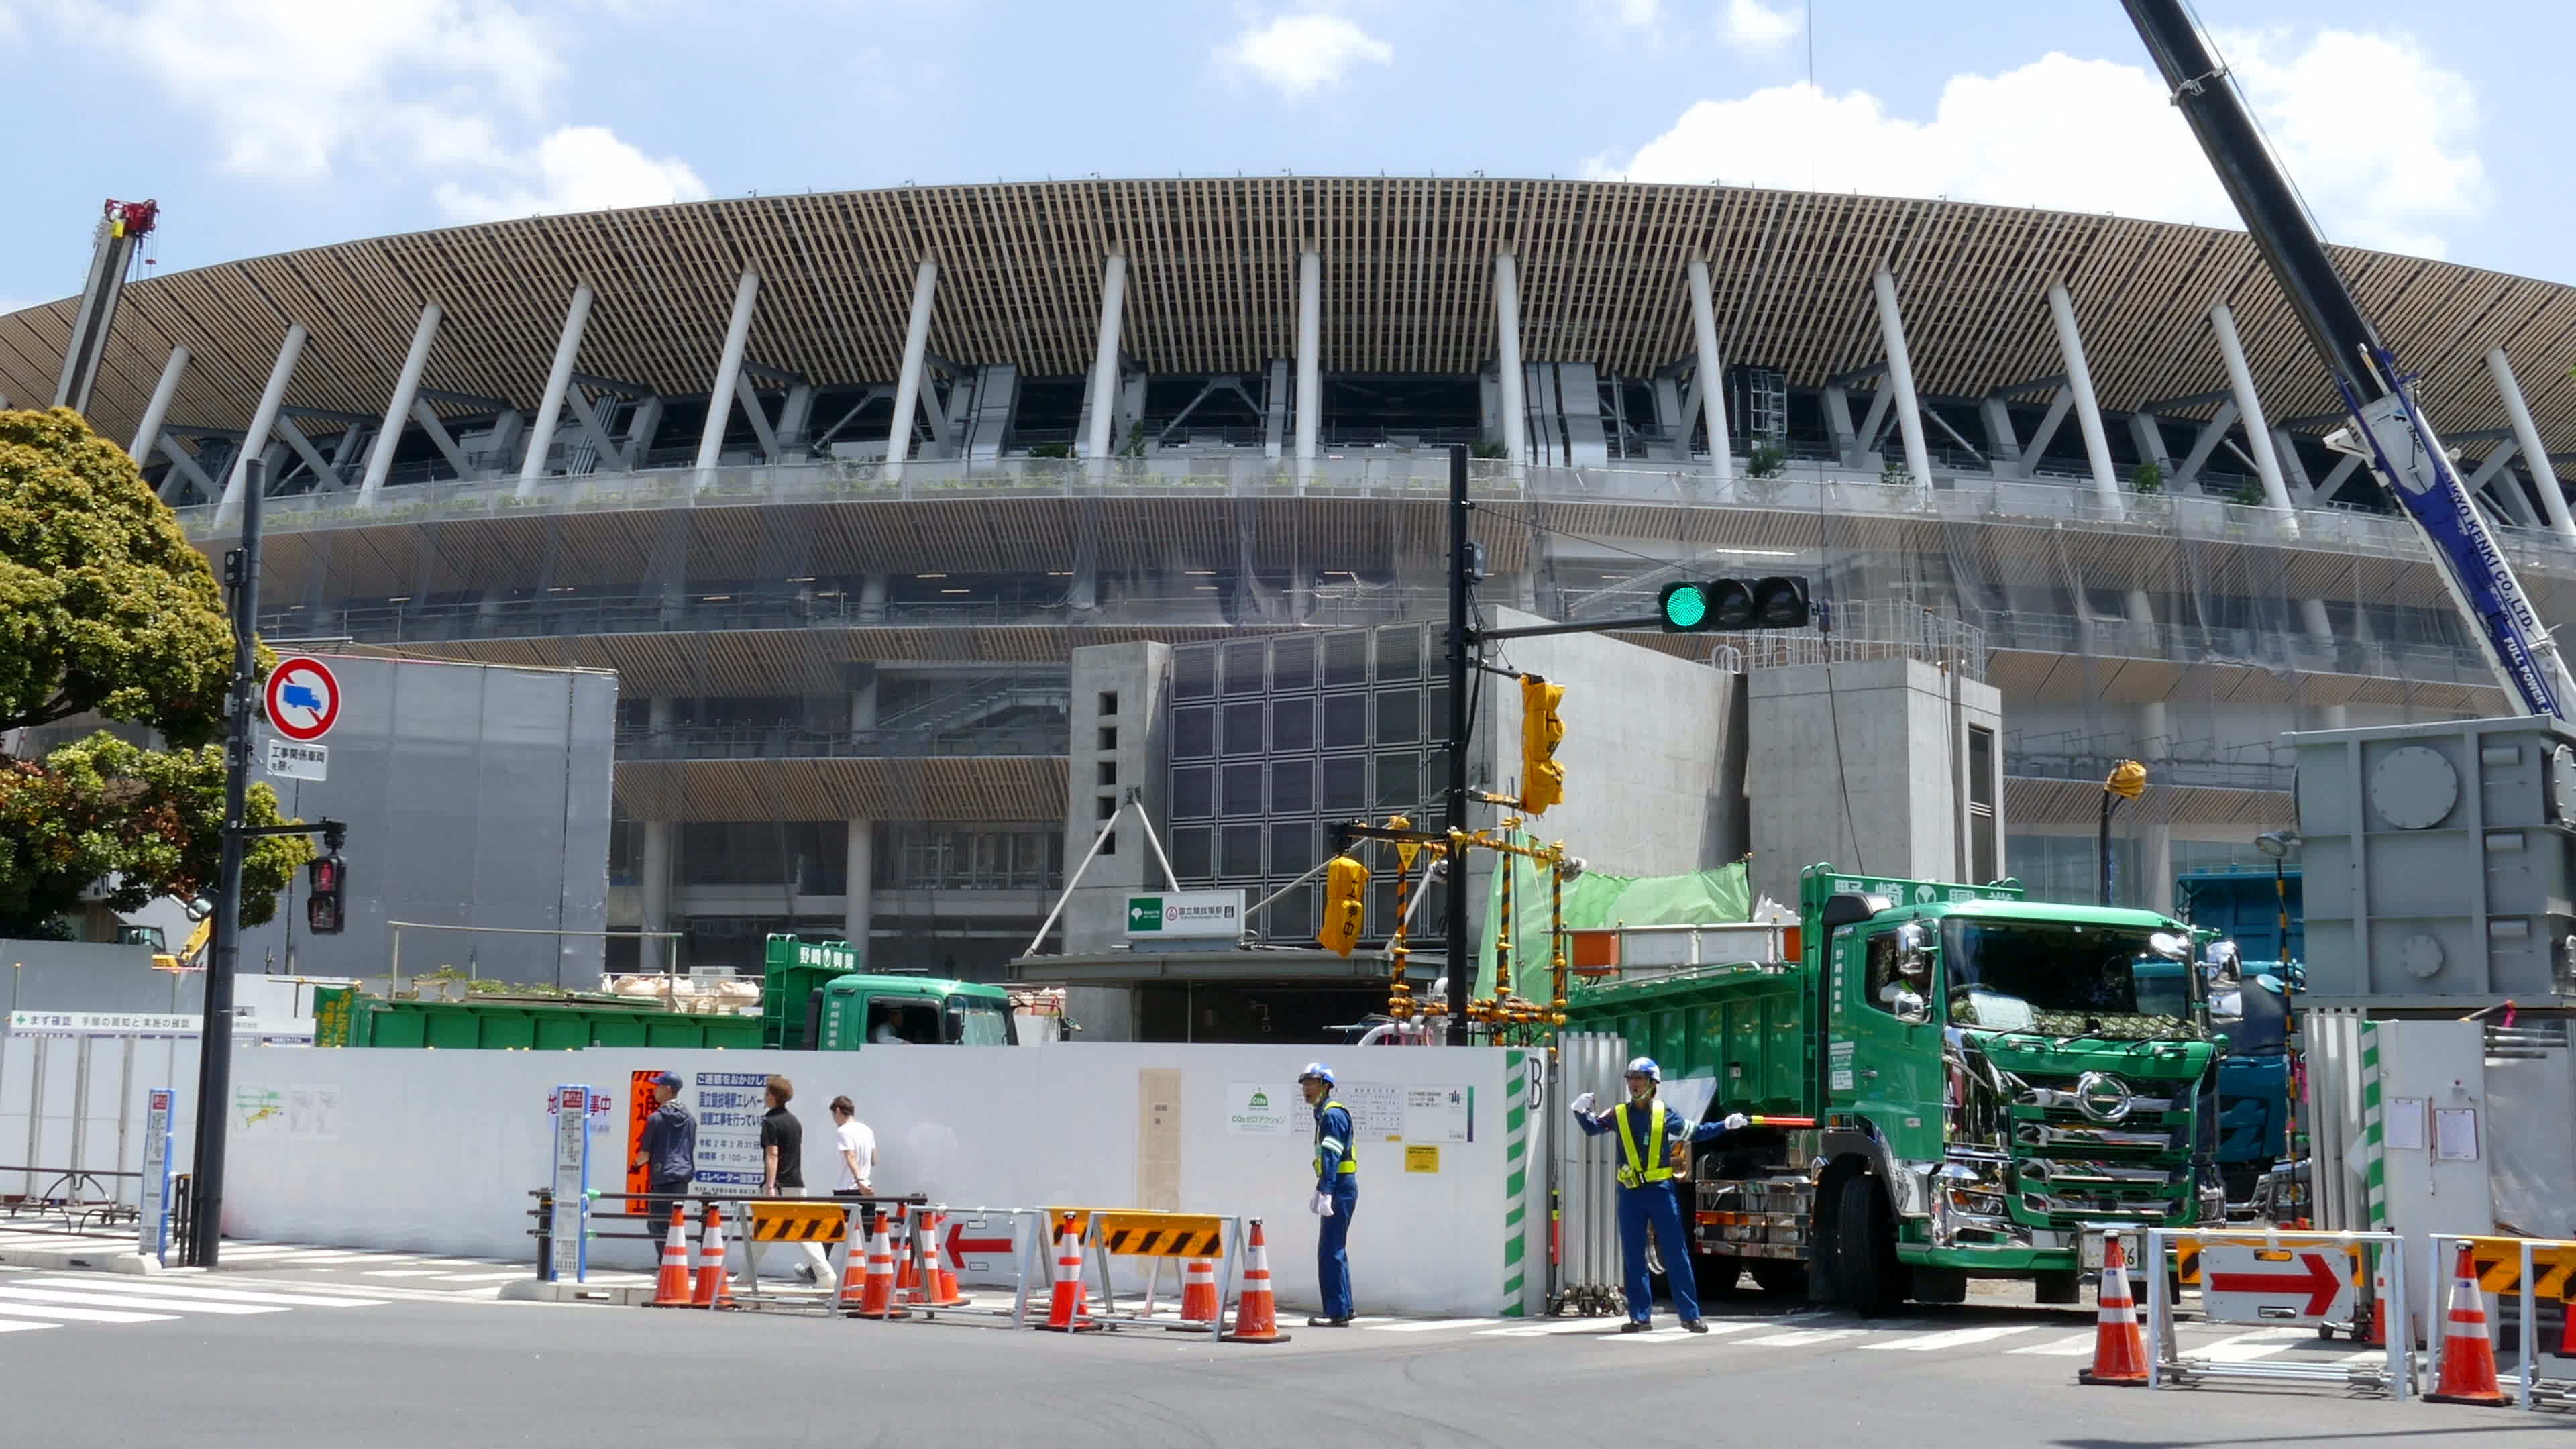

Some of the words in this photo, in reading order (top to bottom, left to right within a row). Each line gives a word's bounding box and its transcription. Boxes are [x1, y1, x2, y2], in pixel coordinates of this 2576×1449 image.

[2467, 519, 2500, 568] KENKI
[2503, 636, 2524, 666] FULL
[2519, 665, 2550, 706] POWER
[1529, 1057, 1542, 1109] B
[700, 1172, 765, 1183] エレベーター設置工
